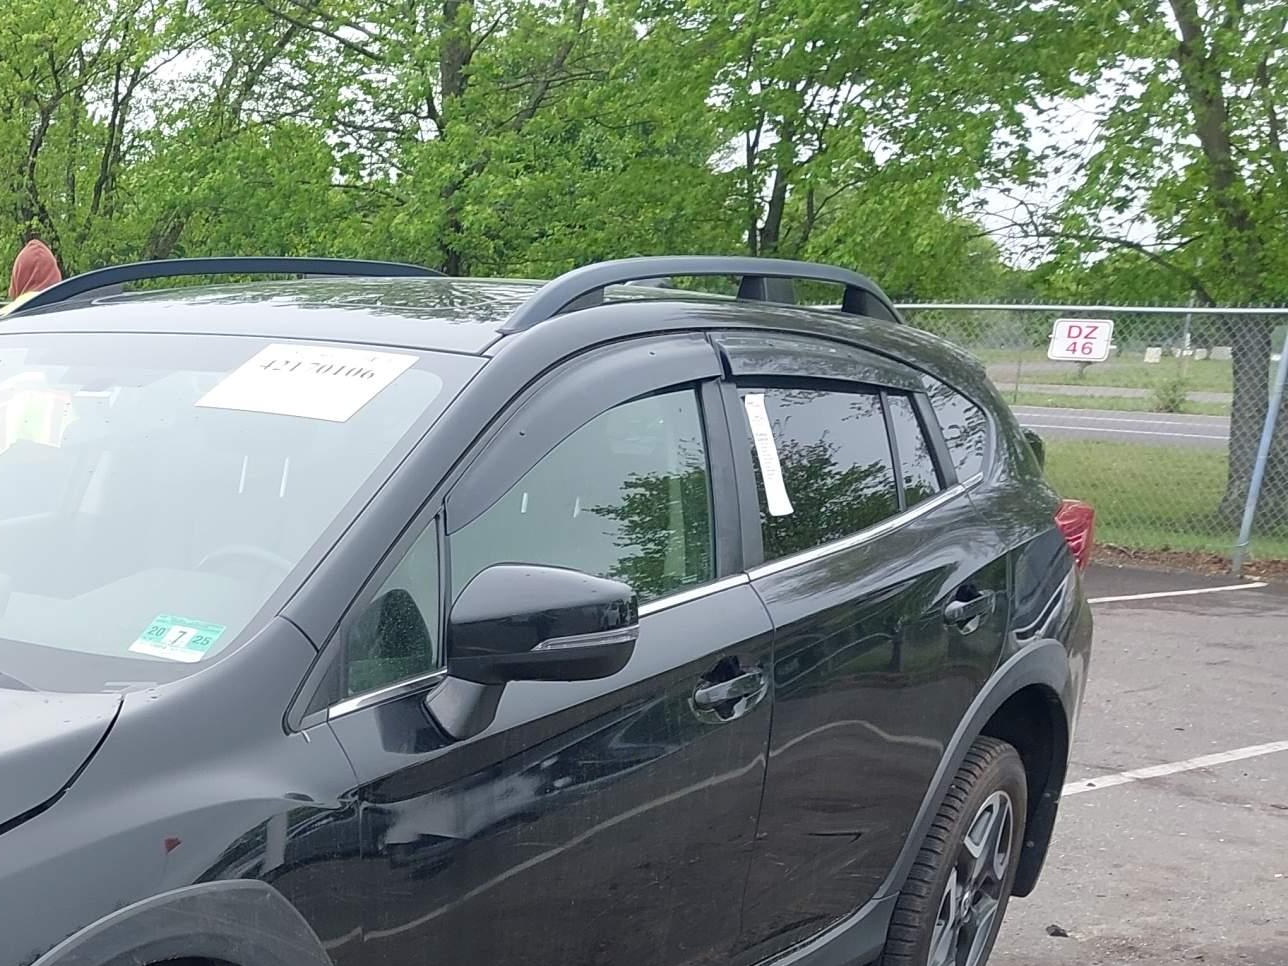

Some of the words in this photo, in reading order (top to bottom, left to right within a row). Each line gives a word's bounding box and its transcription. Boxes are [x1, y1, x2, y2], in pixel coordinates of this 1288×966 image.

[1067, 325, 1099, 340] DZ
[1065, 341, 1094, 355] 46
[147, 625, 167, 637] 20
[191, 635, 213, 646] 25
